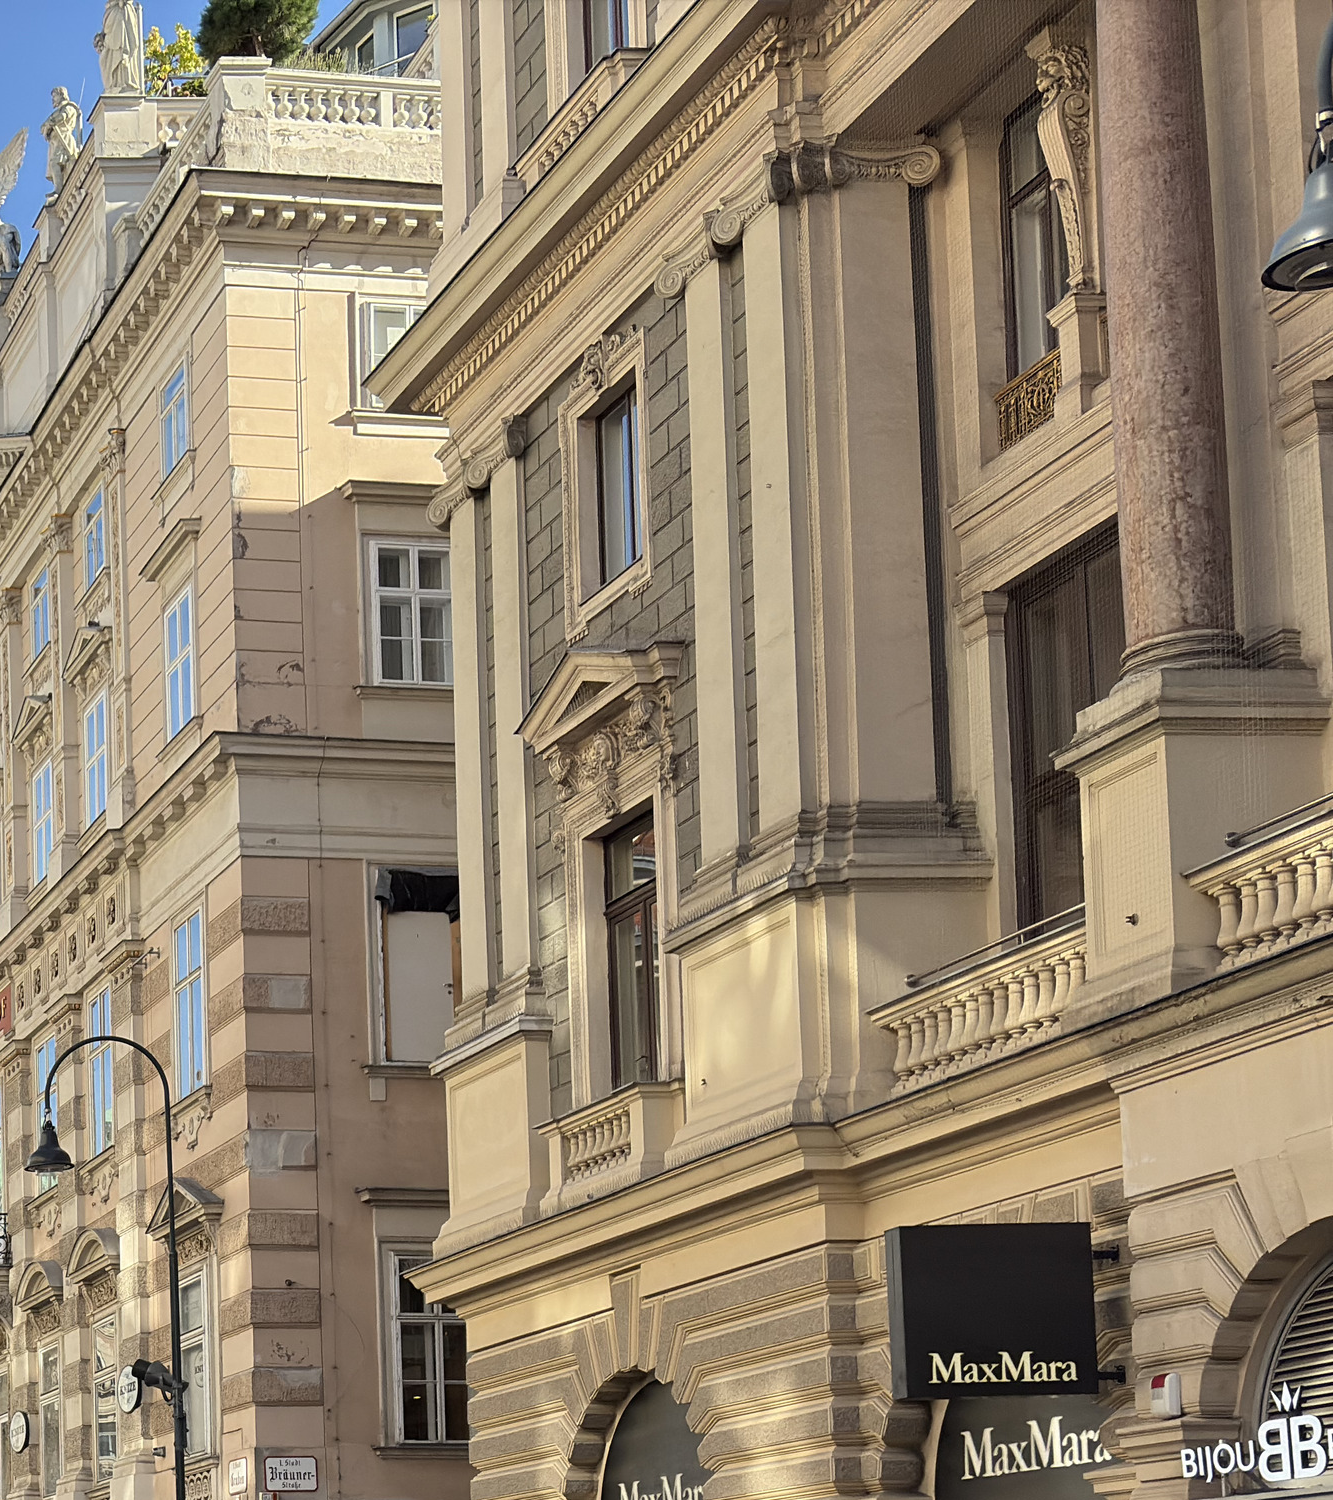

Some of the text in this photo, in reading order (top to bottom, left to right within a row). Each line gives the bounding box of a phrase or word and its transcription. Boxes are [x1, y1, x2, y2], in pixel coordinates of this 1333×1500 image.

[928, 1351, 1079, 1384] MaxMara
[119, 1380, 137, 1396] KNIZE
[1180, 1439, 1256, 1484] BIJOU
[268, 1466, 316, 1482] Bräuner-
